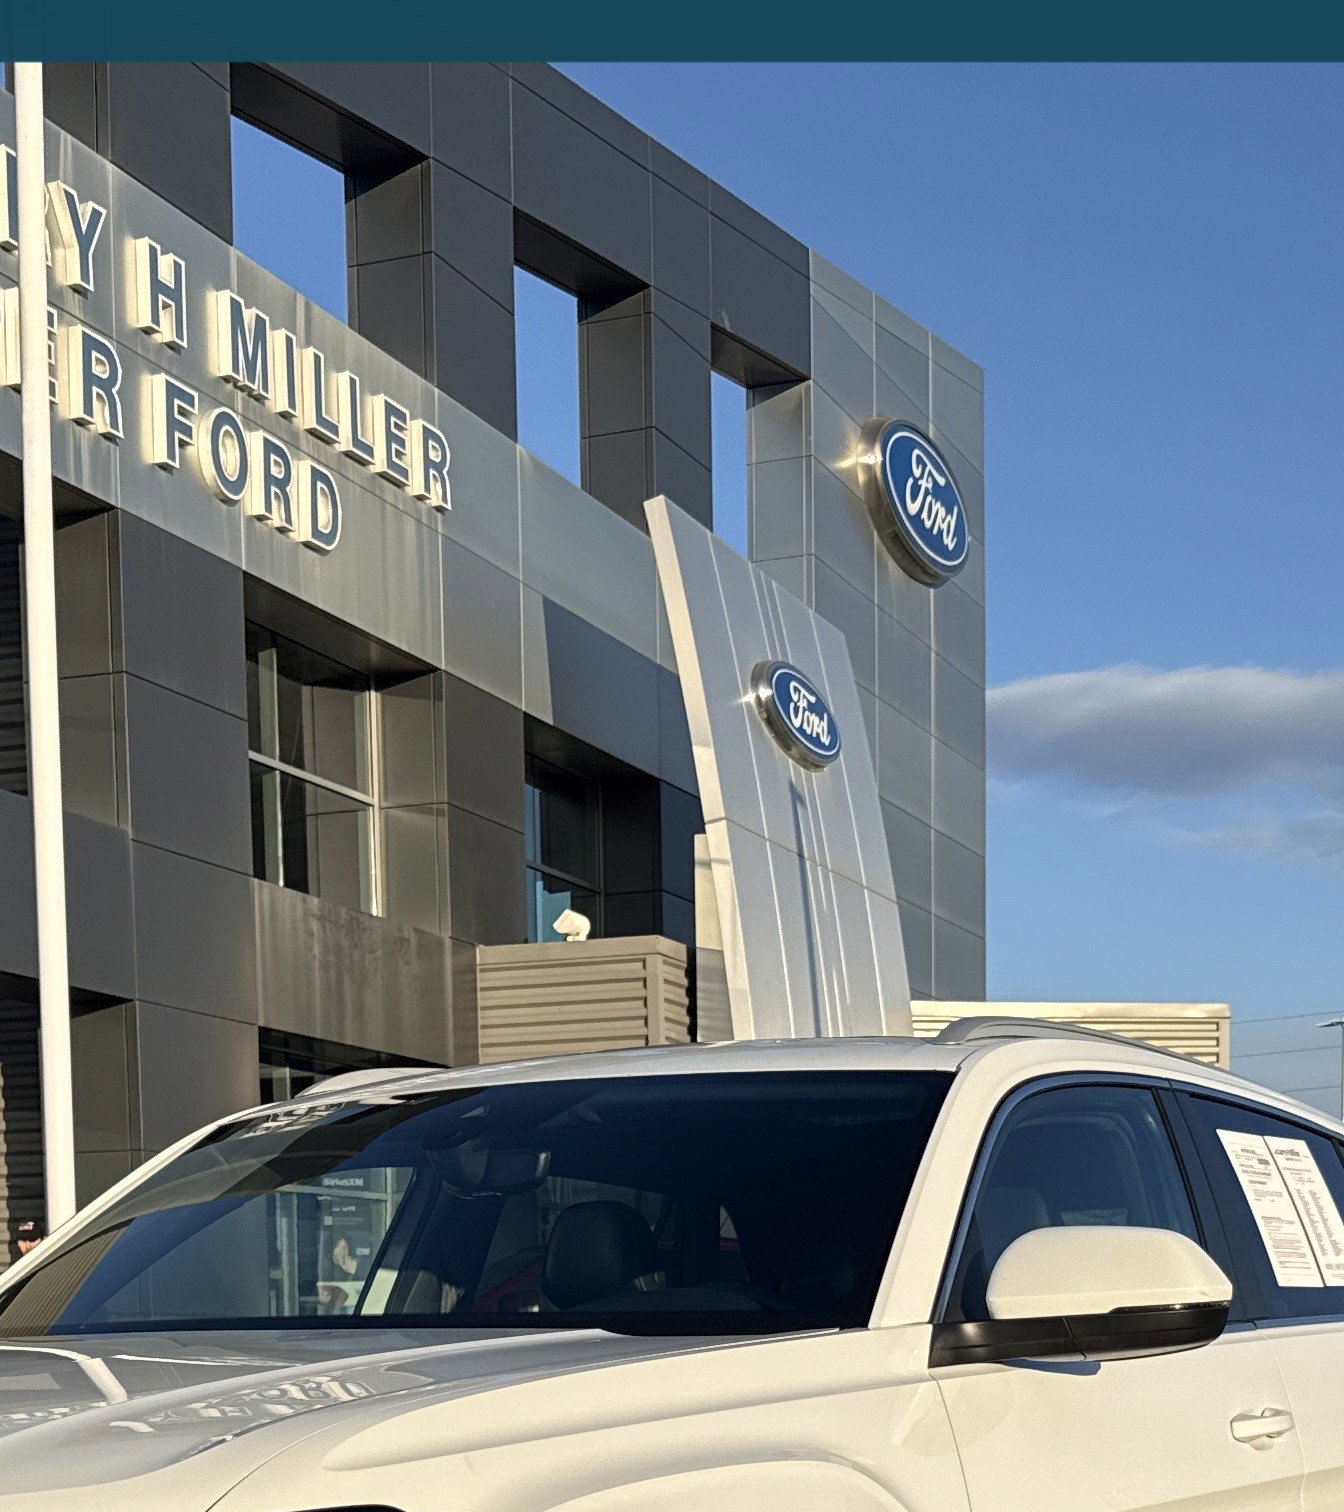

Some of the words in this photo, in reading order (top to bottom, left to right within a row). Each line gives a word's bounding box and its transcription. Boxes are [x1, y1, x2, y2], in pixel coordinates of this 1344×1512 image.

[136, 237, 187, 348] H
[218, 290, 452, 511] MILLER
[154, 373, 343, 551] FORD
[905, 448, 958, 551] Ford
[789, 680, 831, 746] Ford
